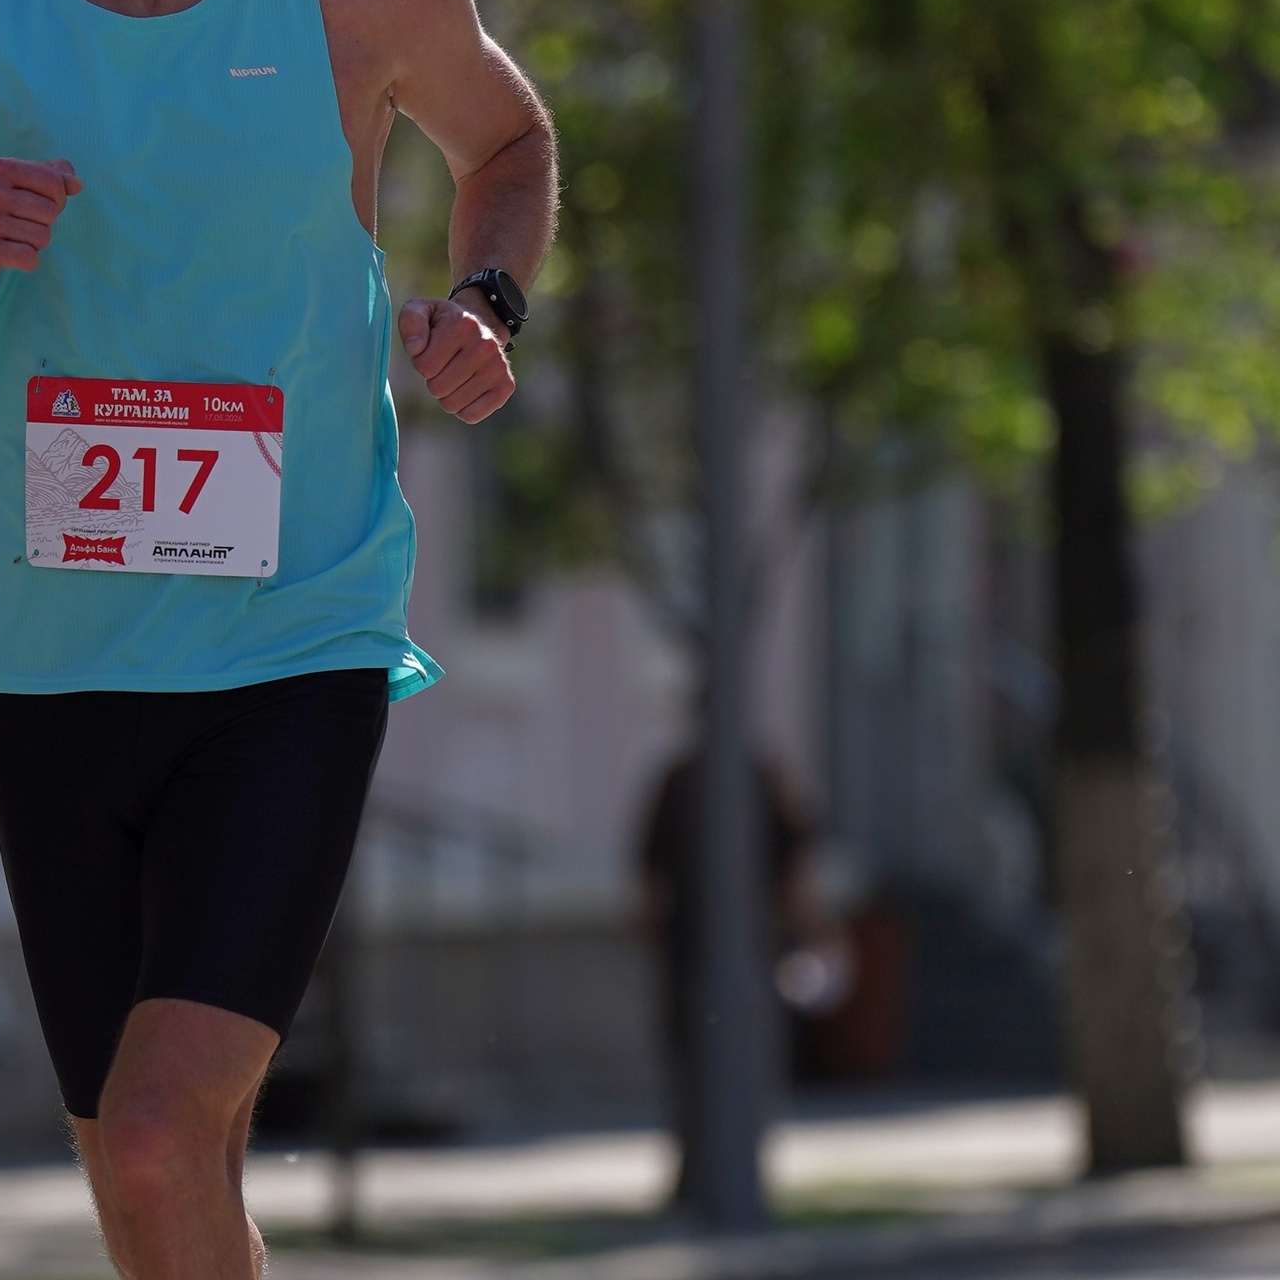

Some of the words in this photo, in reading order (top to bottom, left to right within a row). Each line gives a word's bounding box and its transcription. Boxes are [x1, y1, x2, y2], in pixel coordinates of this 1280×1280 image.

[229, 66, 278, 77] KIPRUN
[111, 388, 150, 404] ТАМ,
[153, 389, 173, 402] ЗА
[94, 403, 190, 420] КУРГАНАМИ
[204, 413, 243, 423] 17.05.2026
[78, 444, 220, 515] 217
[70, 543, 96, 555] Альфа
[96, 544, 118, 553] Банк
